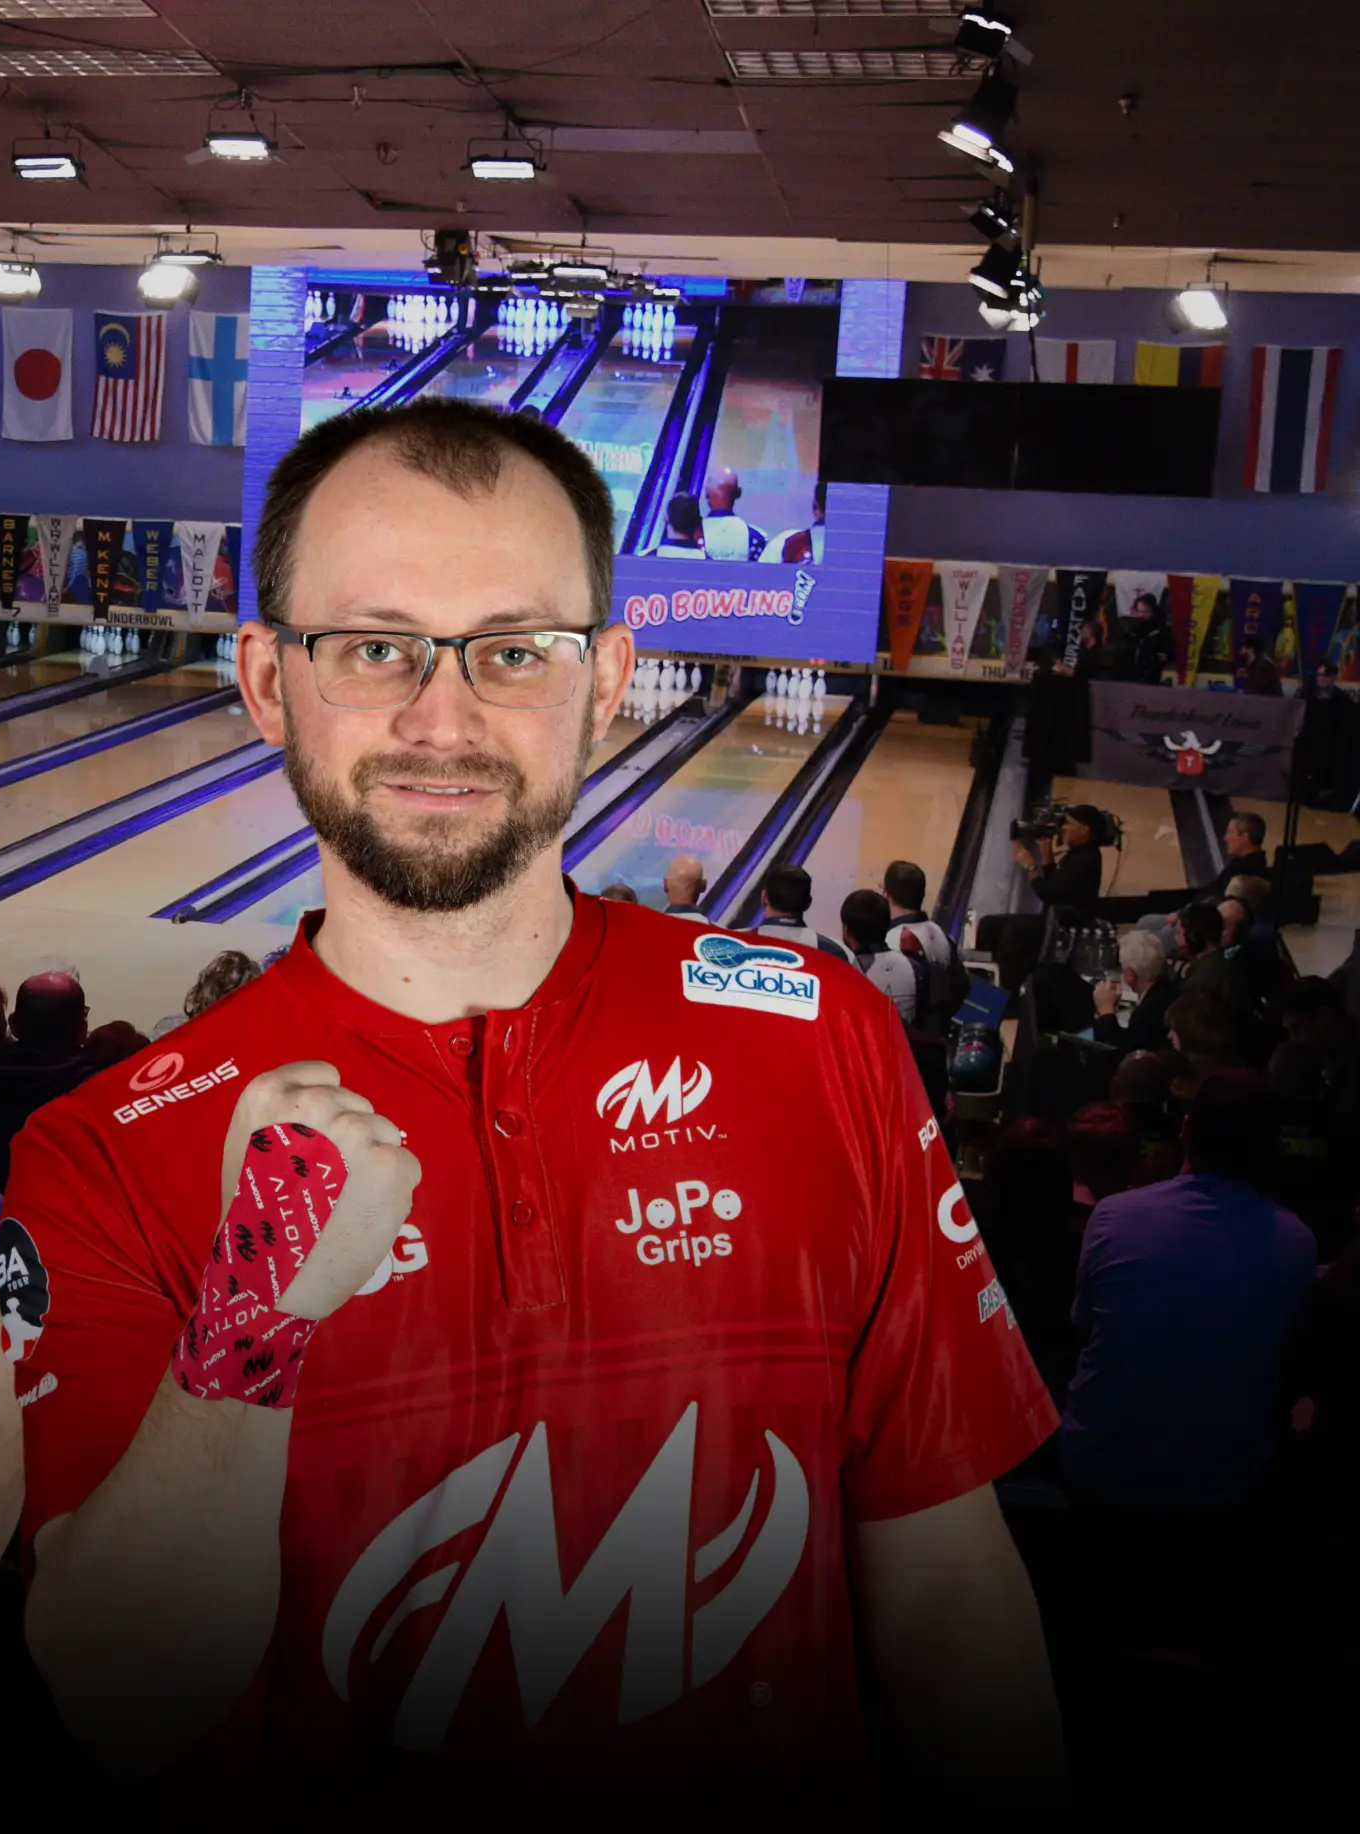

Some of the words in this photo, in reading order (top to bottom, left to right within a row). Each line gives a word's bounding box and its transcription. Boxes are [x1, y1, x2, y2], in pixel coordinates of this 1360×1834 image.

[2, 518, 16, 593] BARNES
[146, 529, 159, 591] WEBER
[192, 533, 206, 614] MALOTT
[106, 611, 175, 627] UNDERBOWL
[625, 594, 668, 629] GO
[950, 580, 969, 670] WILLIAMS
[687, 963, 731, 991] Key
[735, 968, 815, 999] Global
[113, 1059, 240, 1125] GENESIS
[609, 1124, 717, 1153] MOTIV
[268, 1176, 306, 1269] MOTIV
[636, 1231, 732, 1267] Grips
[7, 1275, 30, 1293] TOUR
